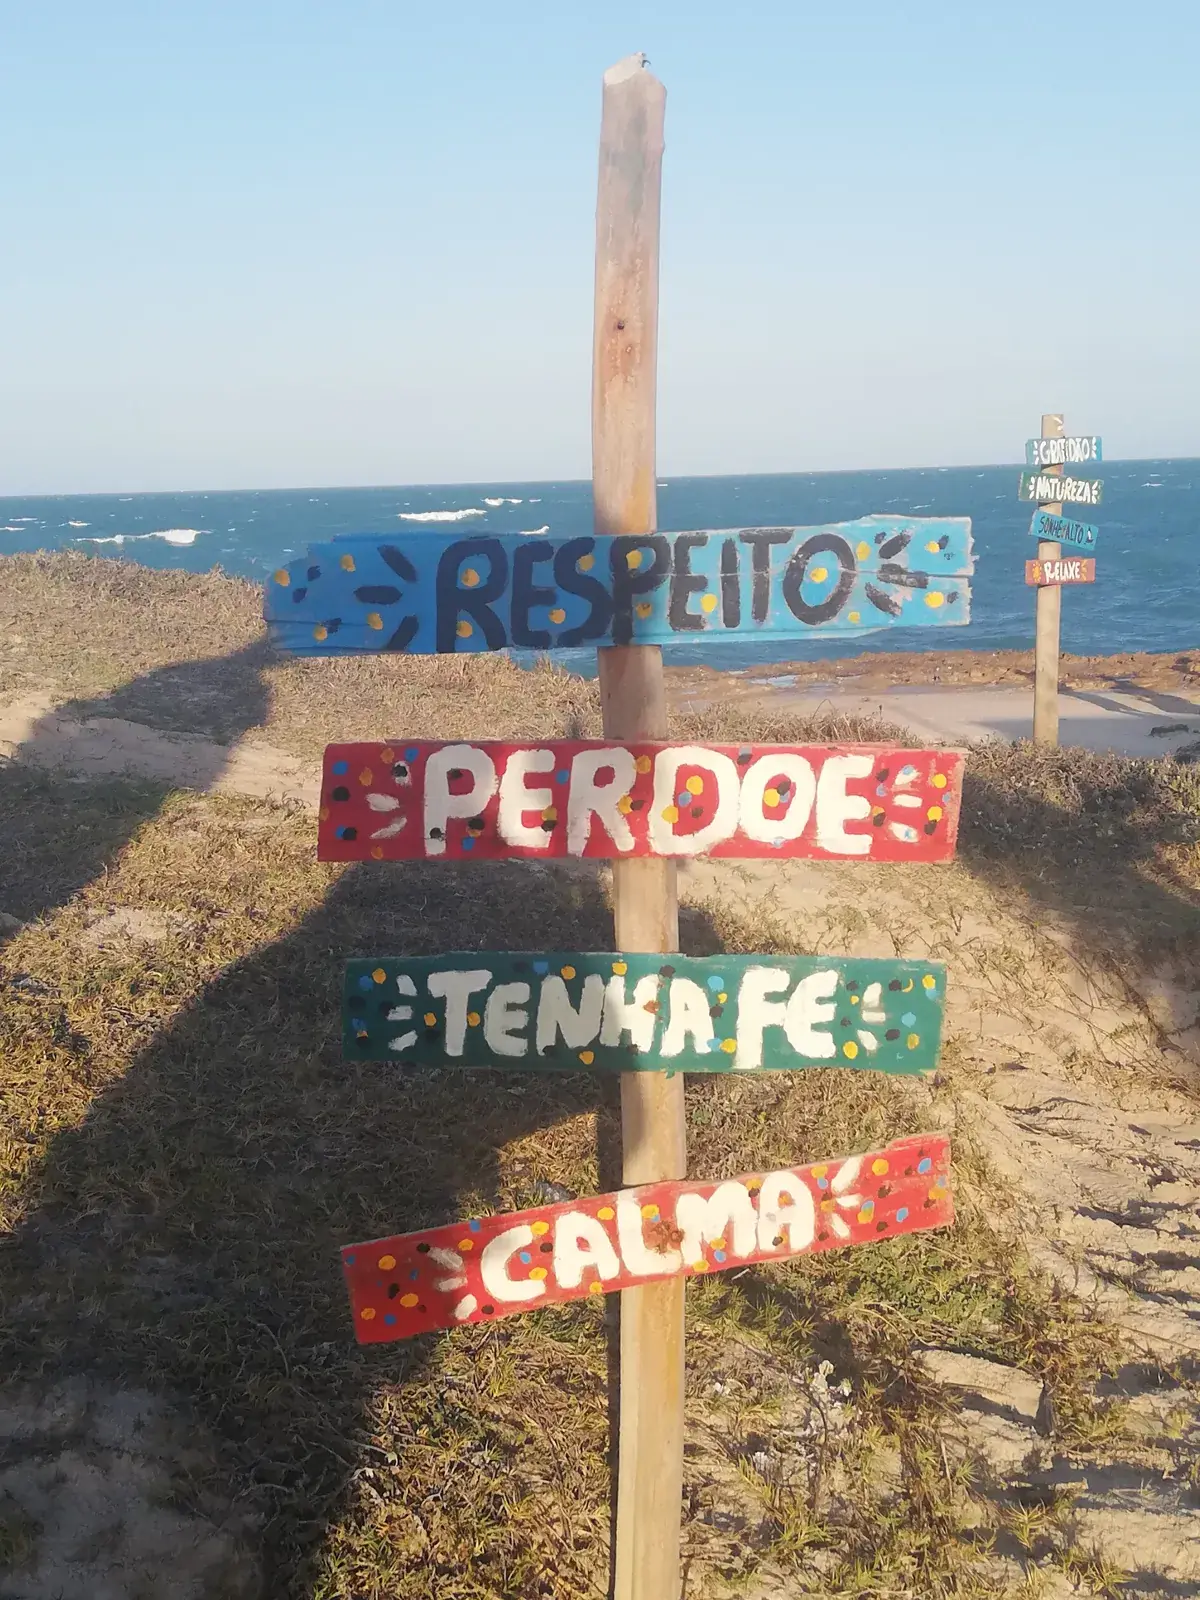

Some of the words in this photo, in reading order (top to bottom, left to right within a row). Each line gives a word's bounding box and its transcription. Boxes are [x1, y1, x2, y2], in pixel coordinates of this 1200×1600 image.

[1036, 476, 1091, 503] NATUREZA
[1065, 523, 1084, 544] ALTO
[435, 529, 856, 653] RESPEITO
[1043, 561, 1081, 583] RELAXE
[424, 744, 875, 857] PERDOE
[427, 969, 713, 1057] TENHA
[735, 967, 840, 1069] FE
[480, 1170, 817, 1302] CALMA
